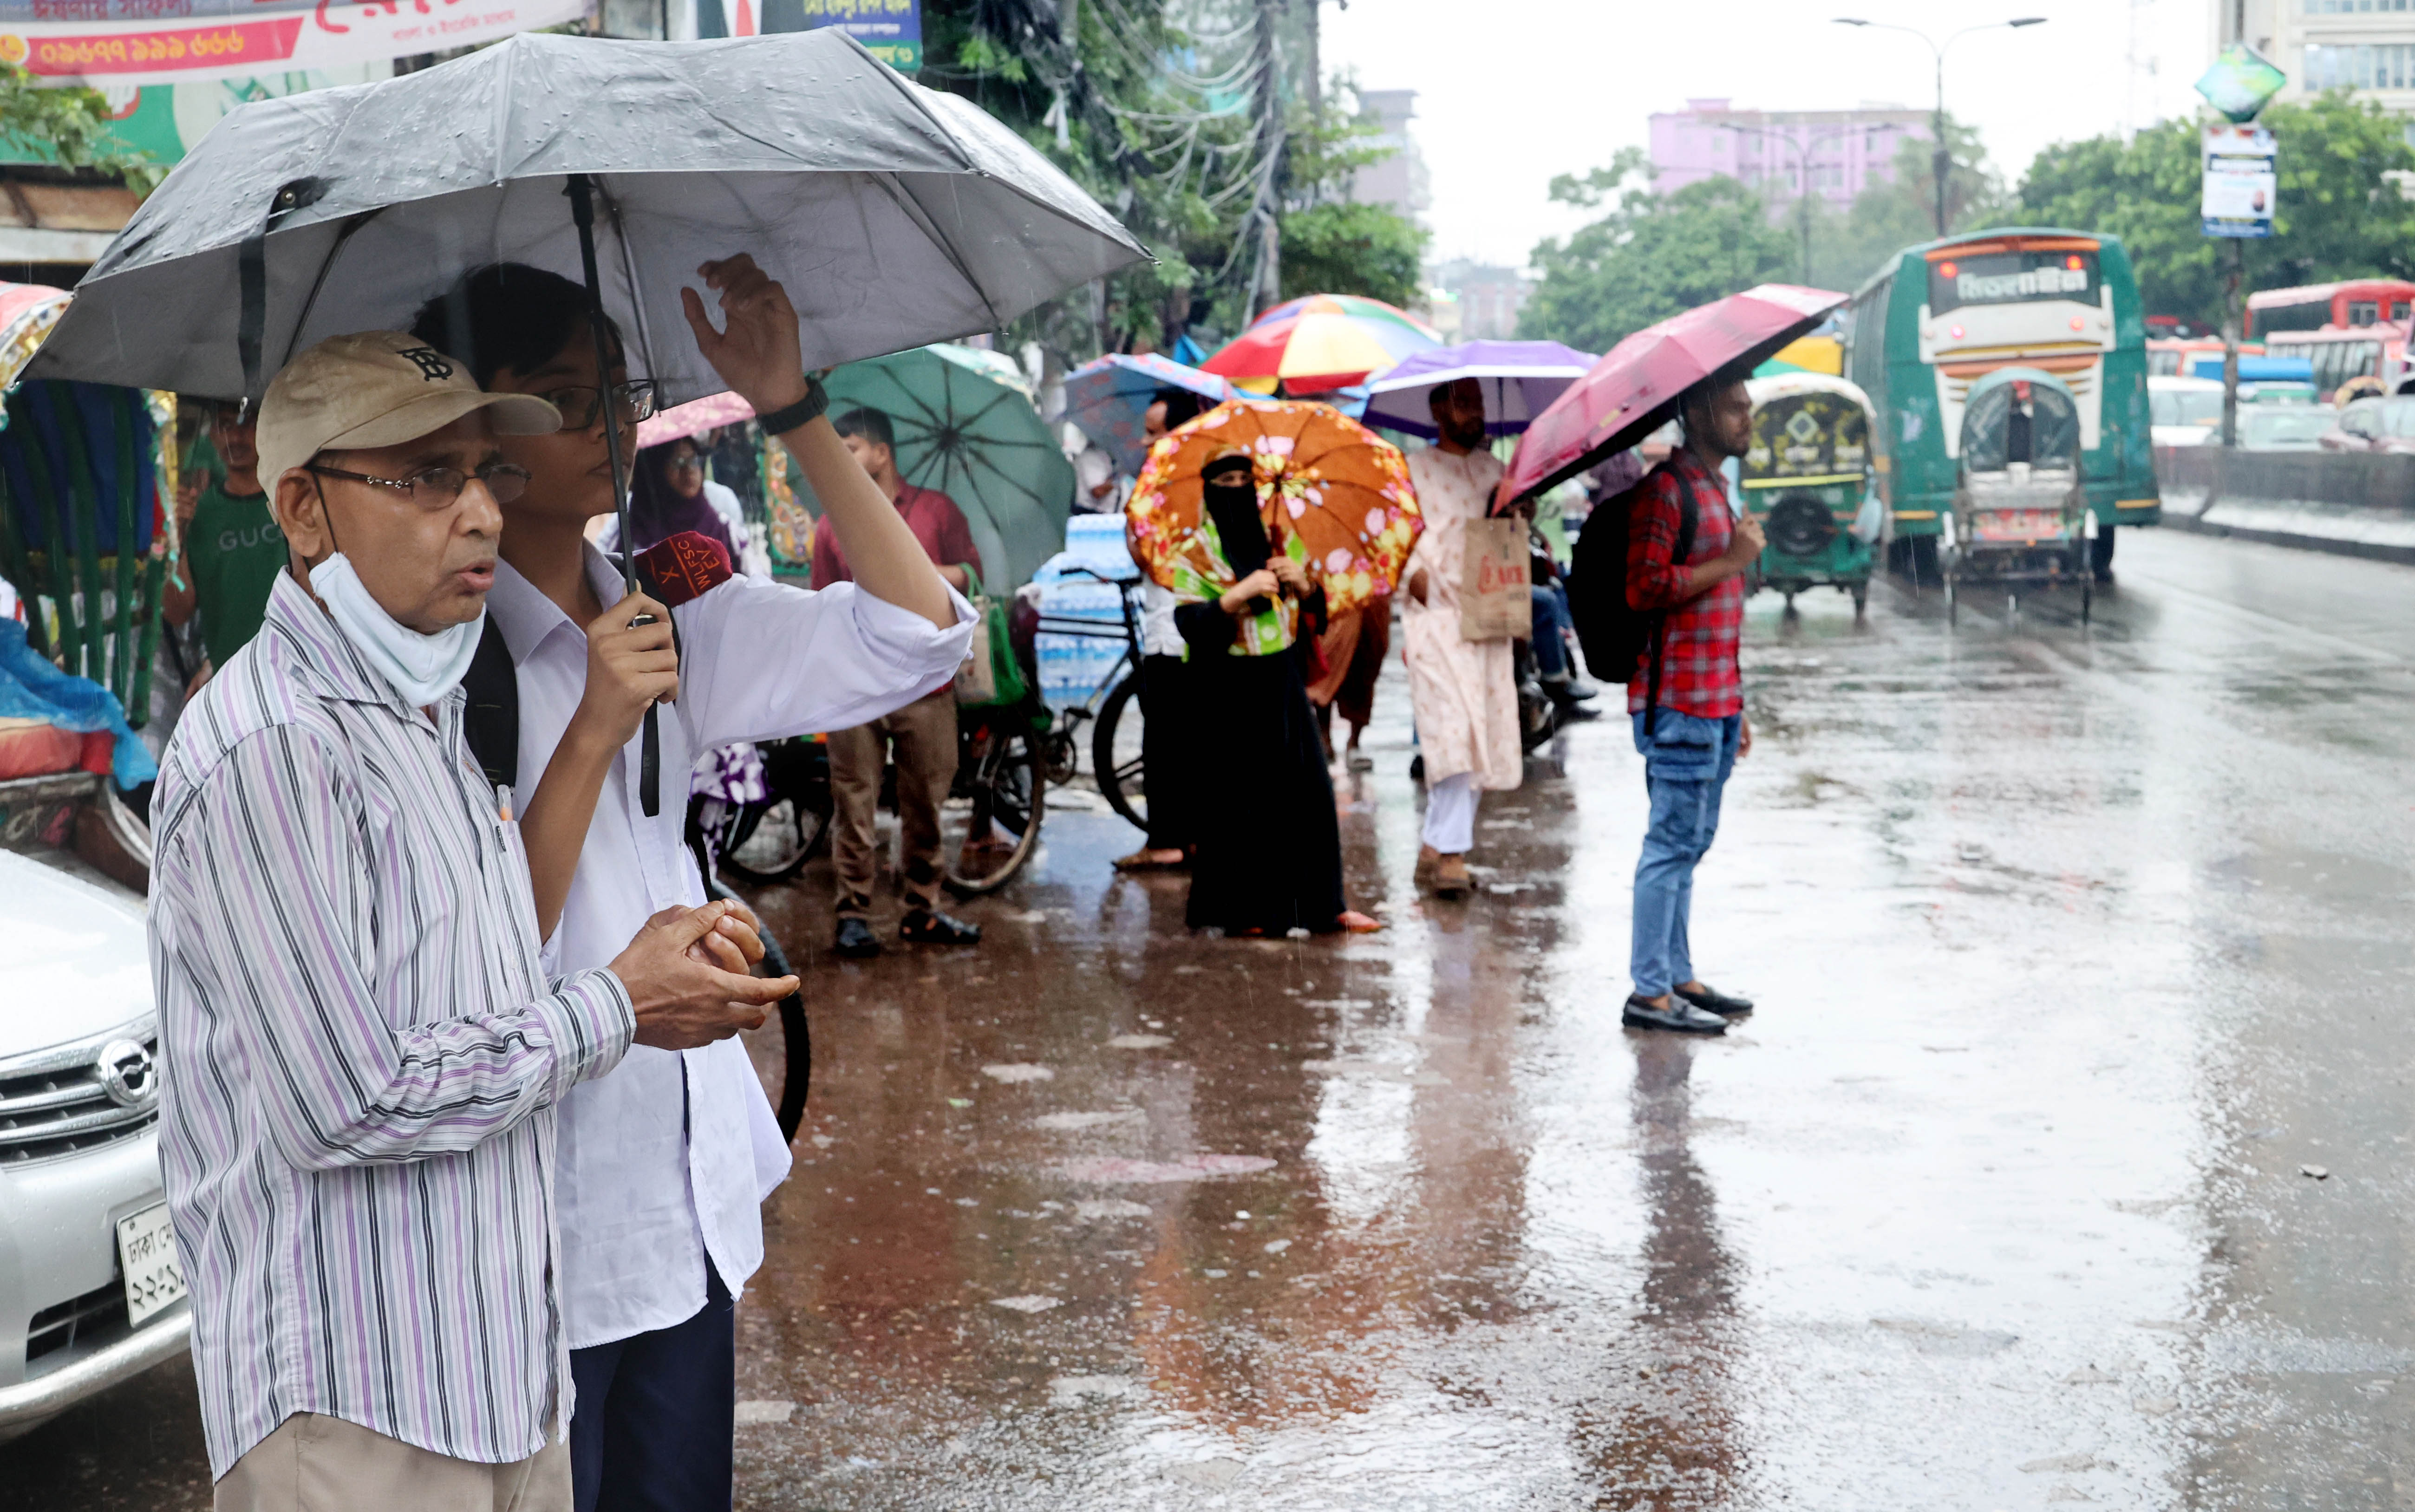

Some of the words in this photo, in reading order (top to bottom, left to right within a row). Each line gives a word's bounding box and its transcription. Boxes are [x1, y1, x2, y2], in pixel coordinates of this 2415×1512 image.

[40, 39, 127, 64] ০৯৬৭৭
[131, 37, 186, 61] ৯৯৯
[126, 1230, 156, 1264] ঢাকা
[132, 1263, 185, 1310] ২২-১
